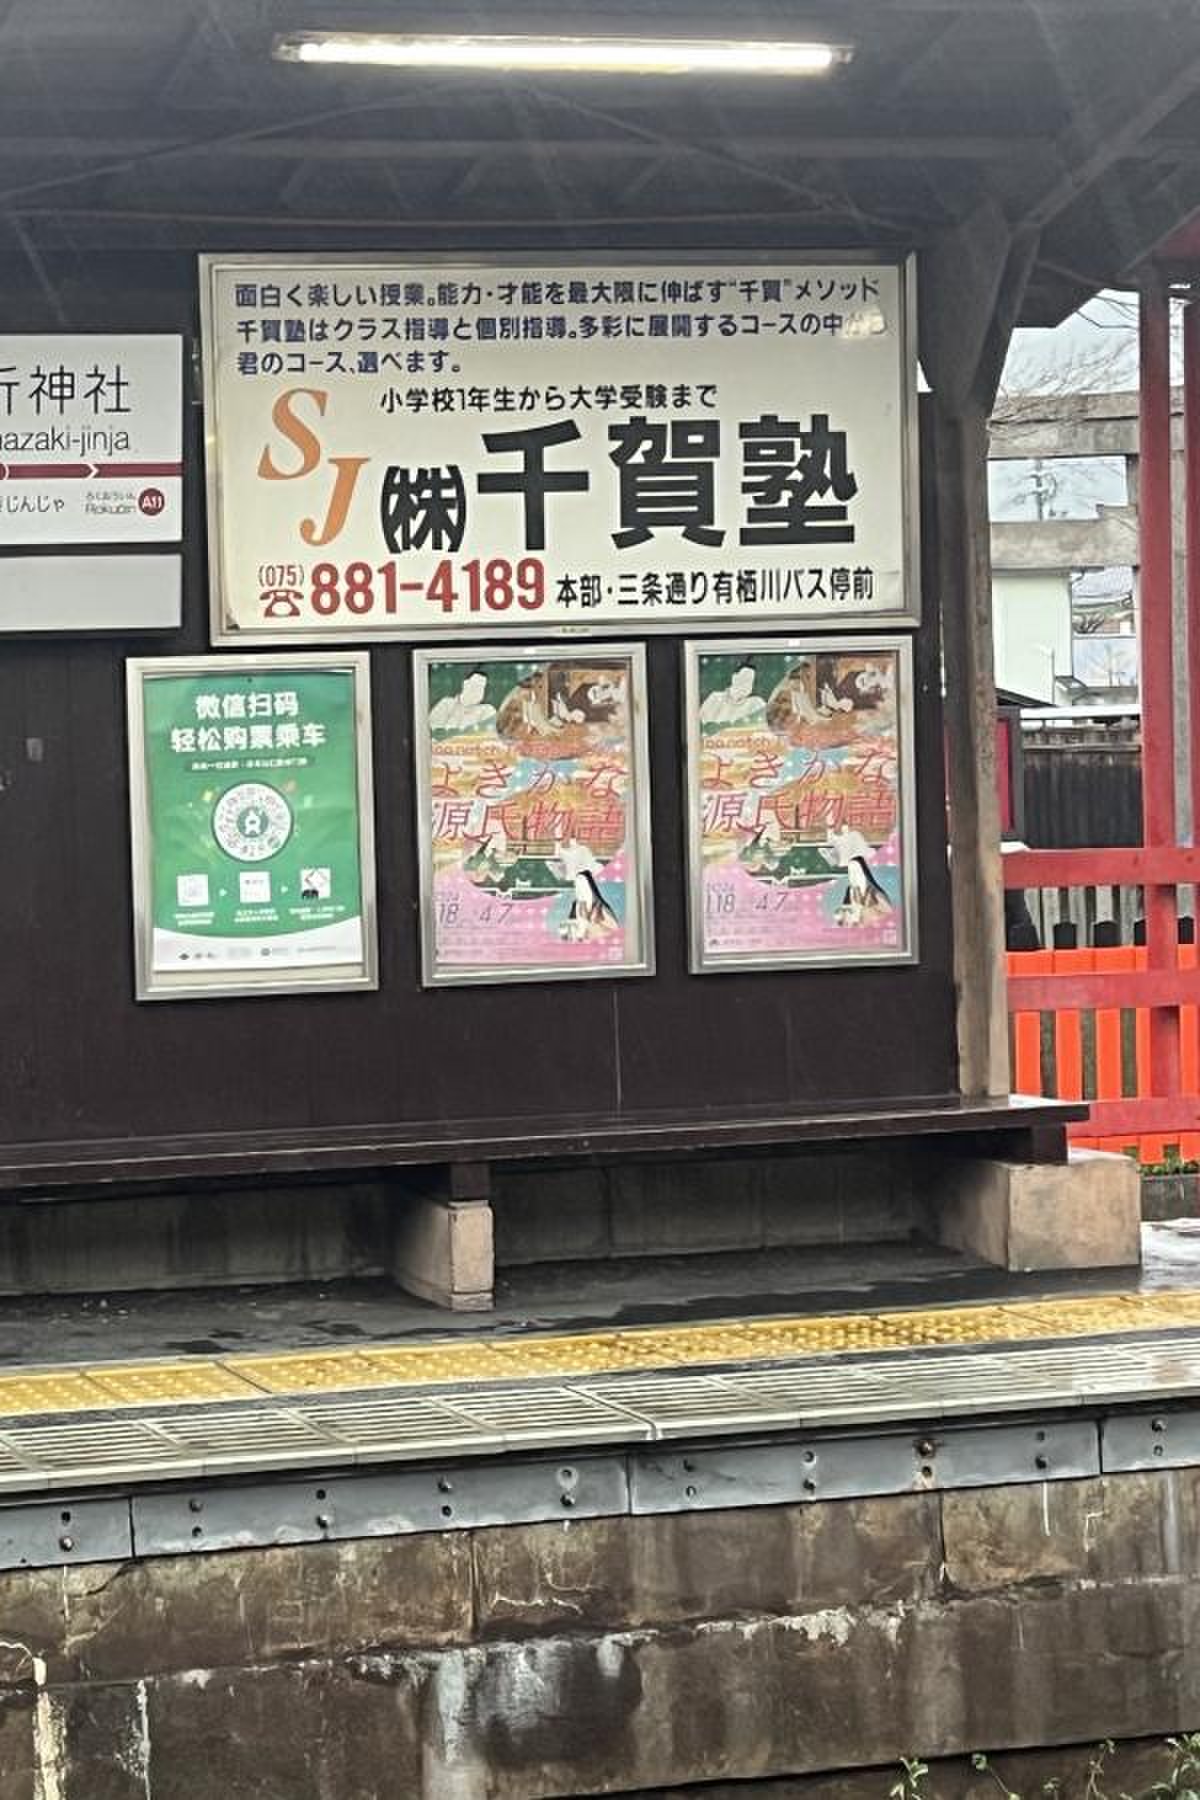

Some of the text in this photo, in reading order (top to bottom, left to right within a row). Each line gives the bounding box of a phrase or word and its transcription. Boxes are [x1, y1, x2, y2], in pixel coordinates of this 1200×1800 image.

[380, 384, 718, 413] 小学校1年生から大学受験まで
[141, 494, 163, 509] A11
[258, 565, 305, 588] (075)
[311, 558, 545, 616] 881-4189
[196, 691, 299, 719] 微信扫码
[171, 722, 326, 752] 轻松购票乘车
[704, 789, 896, 833] 源氏物語
